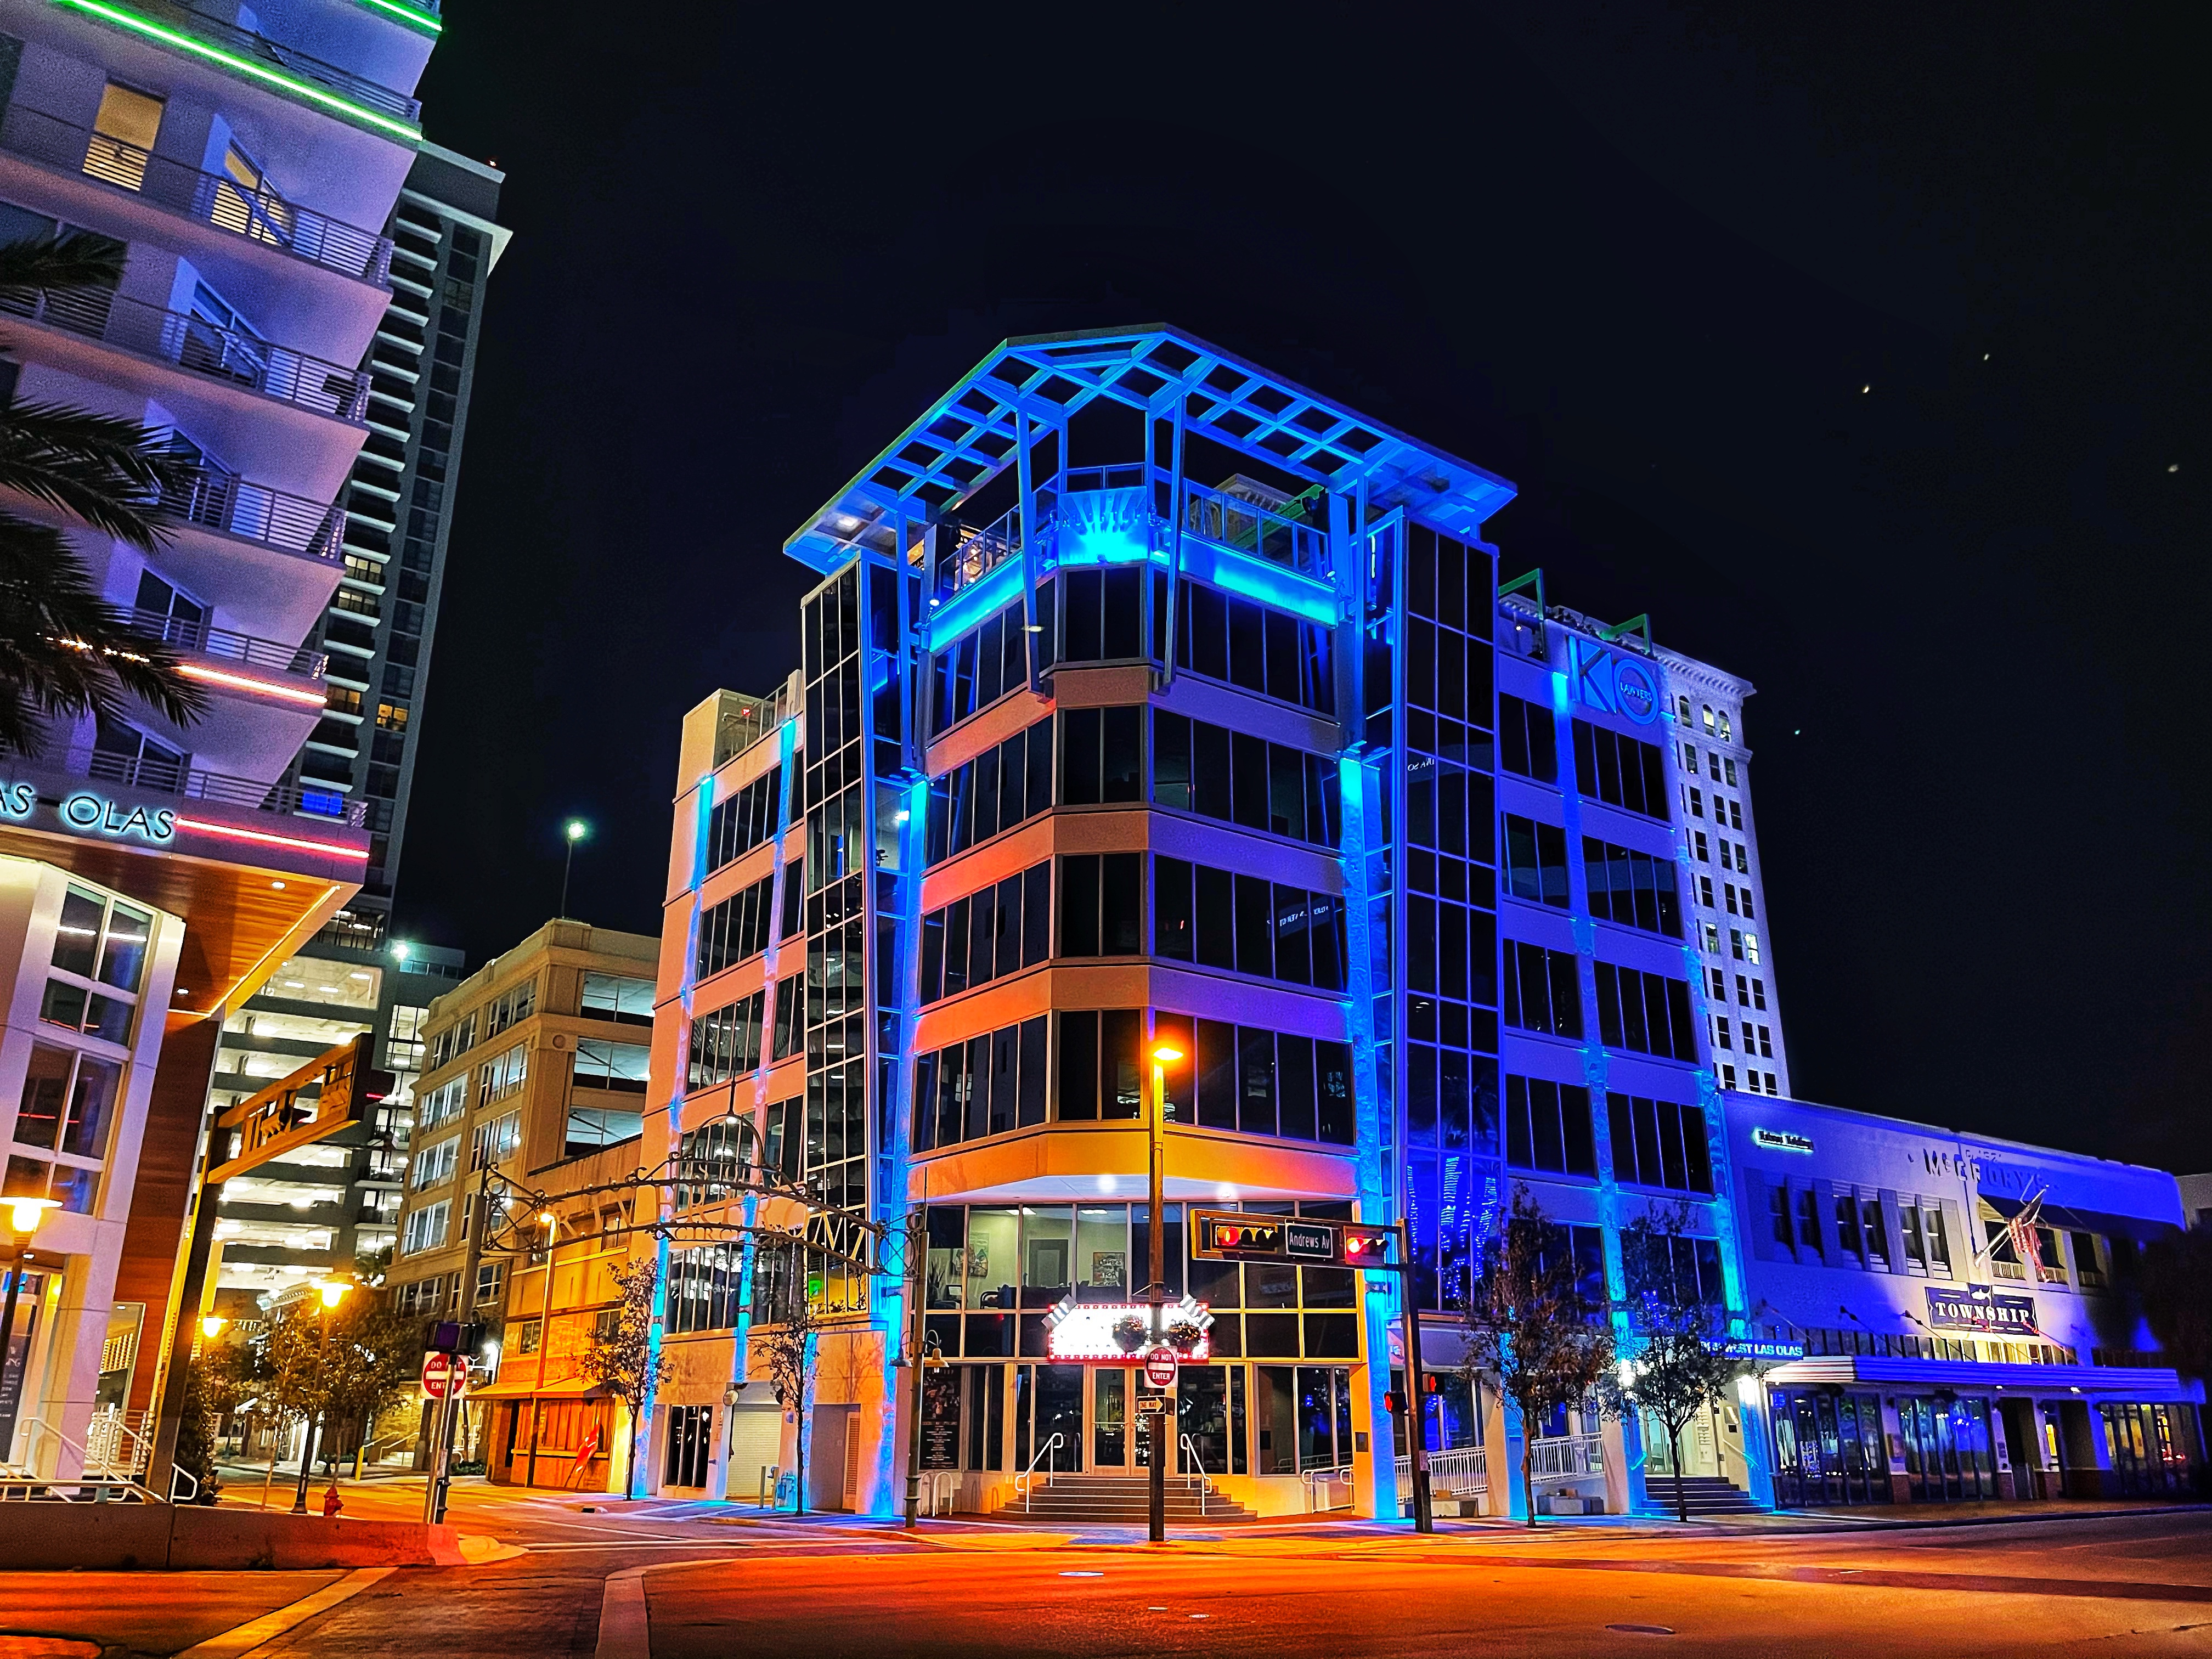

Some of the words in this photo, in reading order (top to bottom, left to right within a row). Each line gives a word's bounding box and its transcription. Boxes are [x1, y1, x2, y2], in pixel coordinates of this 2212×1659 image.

[1620, 682, 1652, 702] LAWYERS
[67, 795, 175, 839] OLAS
[1289, 1232, 1319, 1248] Andrews
[1322, 1234, 1330, 1249] Av
[1935, 1301, 2029, 1323] TOWNSHIP
[1754, 1344, 1775, 1355] LAS
[1776, 1345, 1803, 1356] OLAS
[431, 1361, 442, 1369] DO
[1152, 1372, 1170, 1380] ENTER
